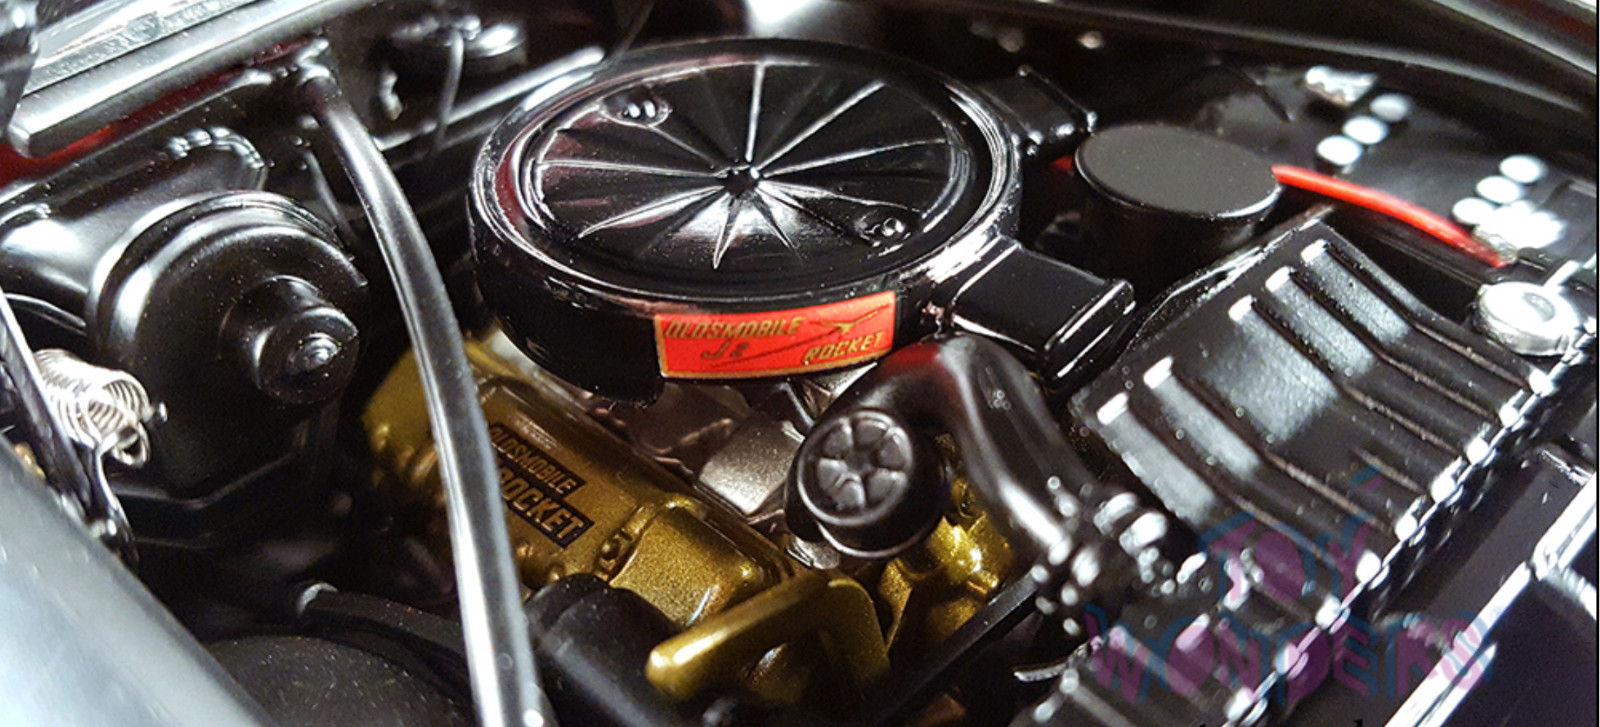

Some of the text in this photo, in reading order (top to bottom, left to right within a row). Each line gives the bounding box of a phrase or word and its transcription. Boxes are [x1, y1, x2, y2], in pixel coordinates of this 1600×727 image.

[664, 316, 804, 339] OLDSMOBILE
[802, 332, 887, 363] ROCKET
[490, 426, 578, 494] OLDSMOBILE
